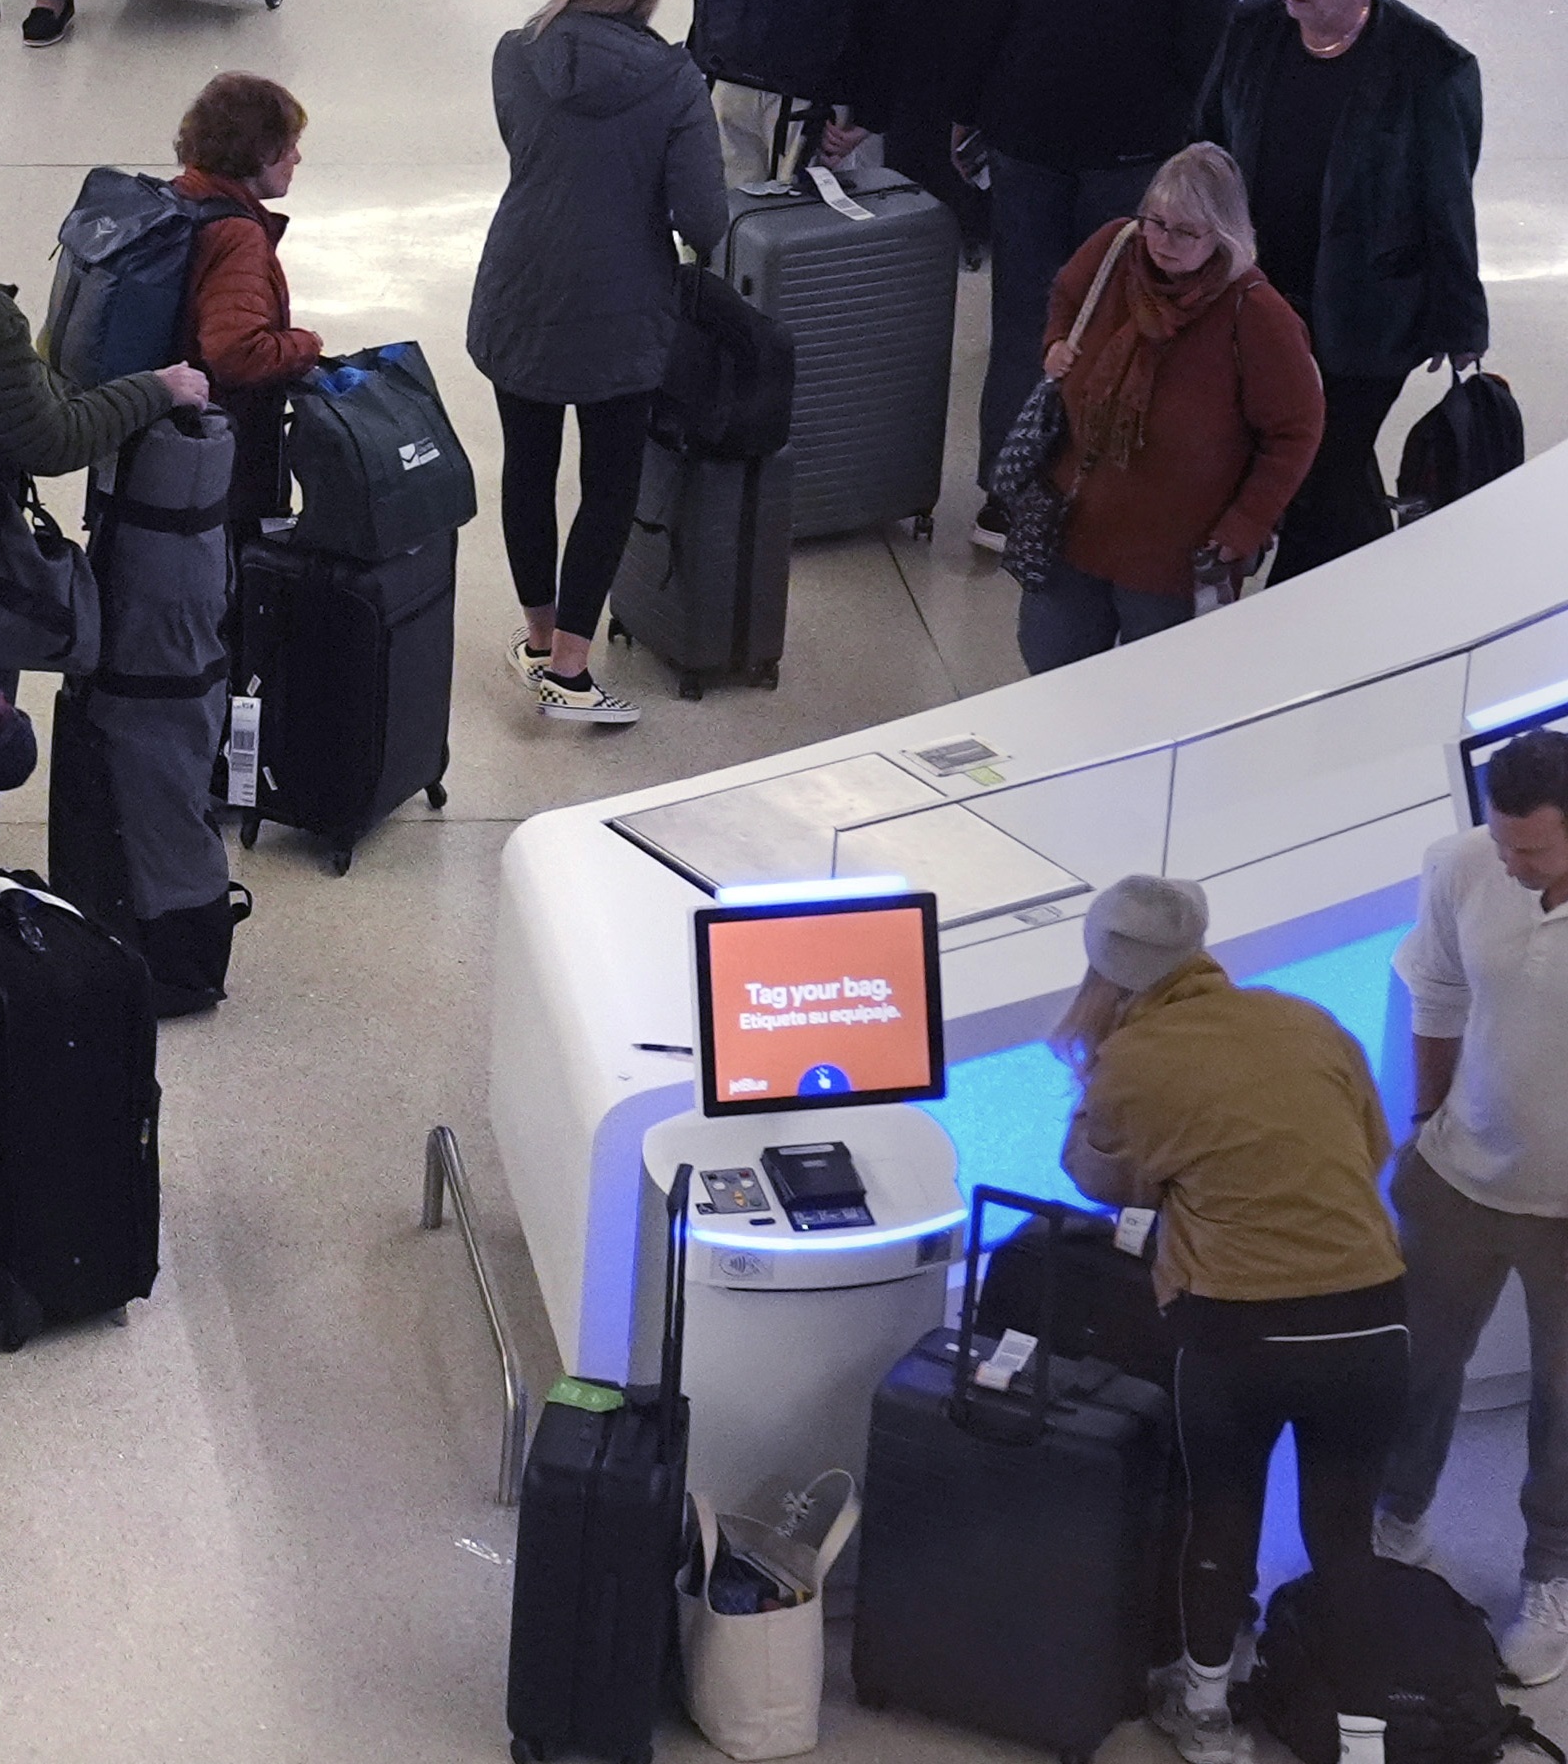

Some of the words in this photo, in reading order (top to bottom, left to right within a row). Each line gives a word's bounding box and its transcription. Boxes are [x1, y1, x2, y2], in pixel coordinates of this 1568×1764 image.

[744, 982, 788, 1008] Tag
[789, 981, 841, 1007] your
[843, 976, 893, 1001] bag.
[739, 1011, 807, 1030] Etiquete
[808, 1009, 829, 1024] su
